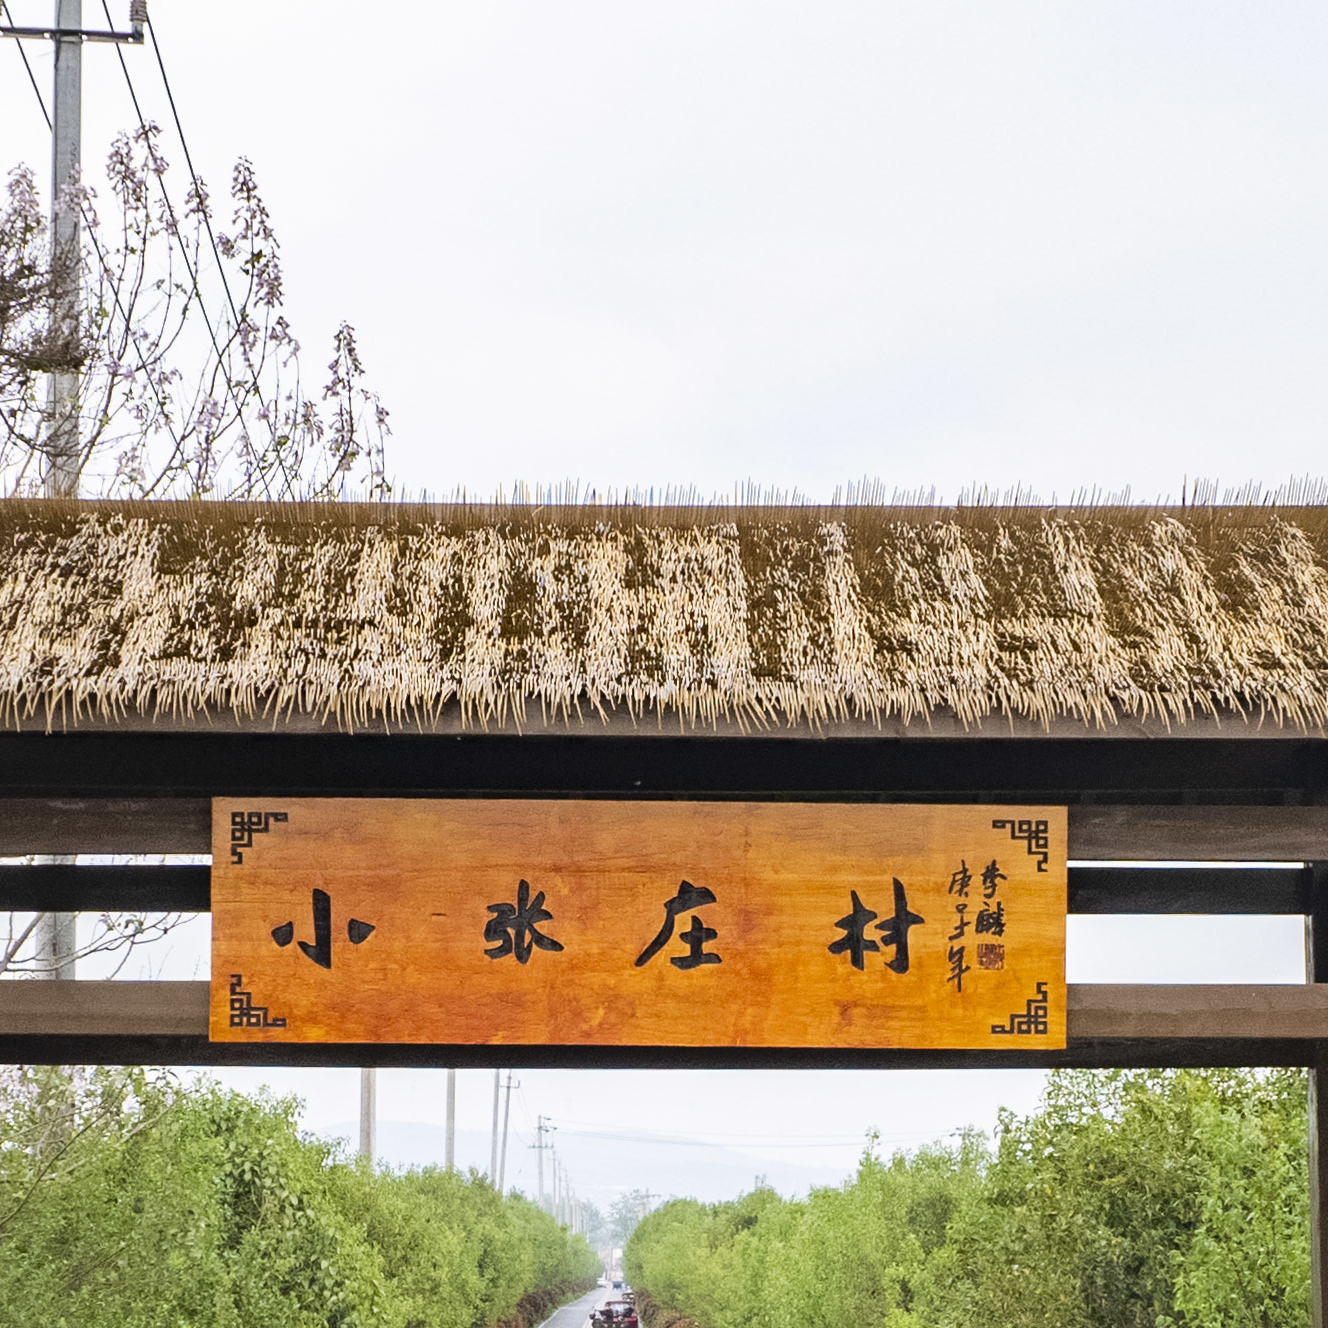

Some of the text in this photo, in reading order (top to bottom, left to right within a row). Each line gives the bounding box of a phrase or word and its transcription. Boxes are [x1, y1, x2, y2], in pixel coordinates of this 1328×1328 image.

[271, 878, 924, 973] 小张庄村
[947, 859, 972, 993] 庚子年
